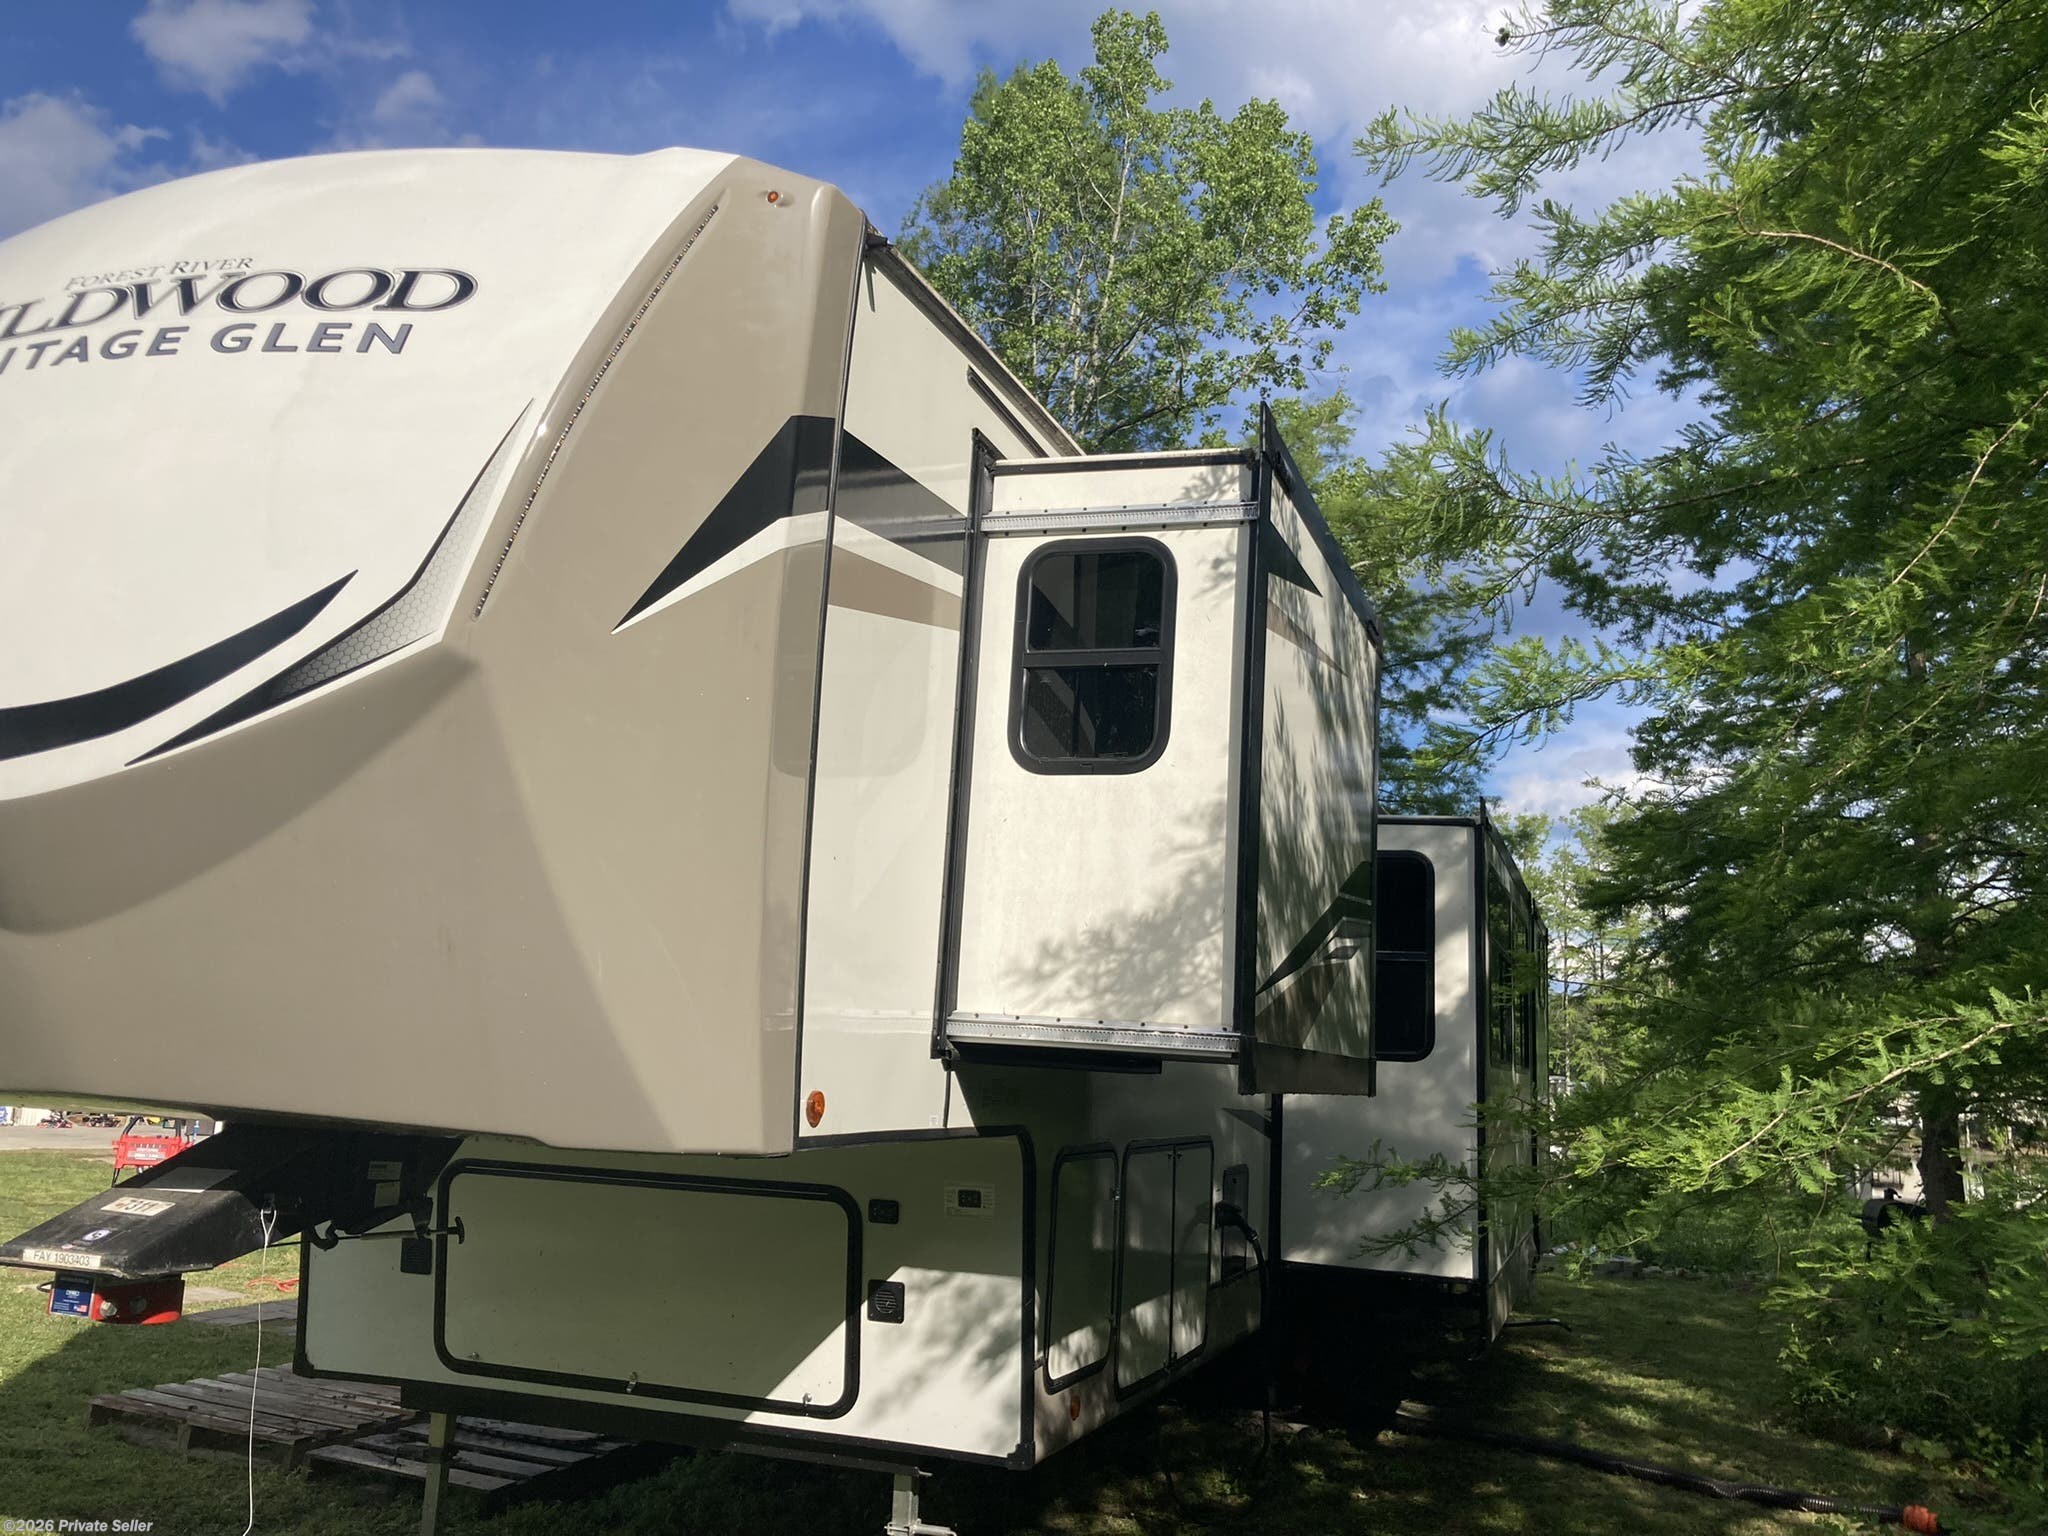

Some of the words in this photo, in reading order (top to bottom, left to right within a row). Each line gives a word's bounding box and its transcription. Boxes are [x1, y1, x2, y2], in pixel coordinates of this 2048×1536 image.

[64, 265, 165, 291] FOREST
[169, 257, 253, 274] RIVER
[0, 267, 479, 341] LDWOOD
[210, 322, 413, 355] GLEN
[33, 1249, 51, 1262] FAY
